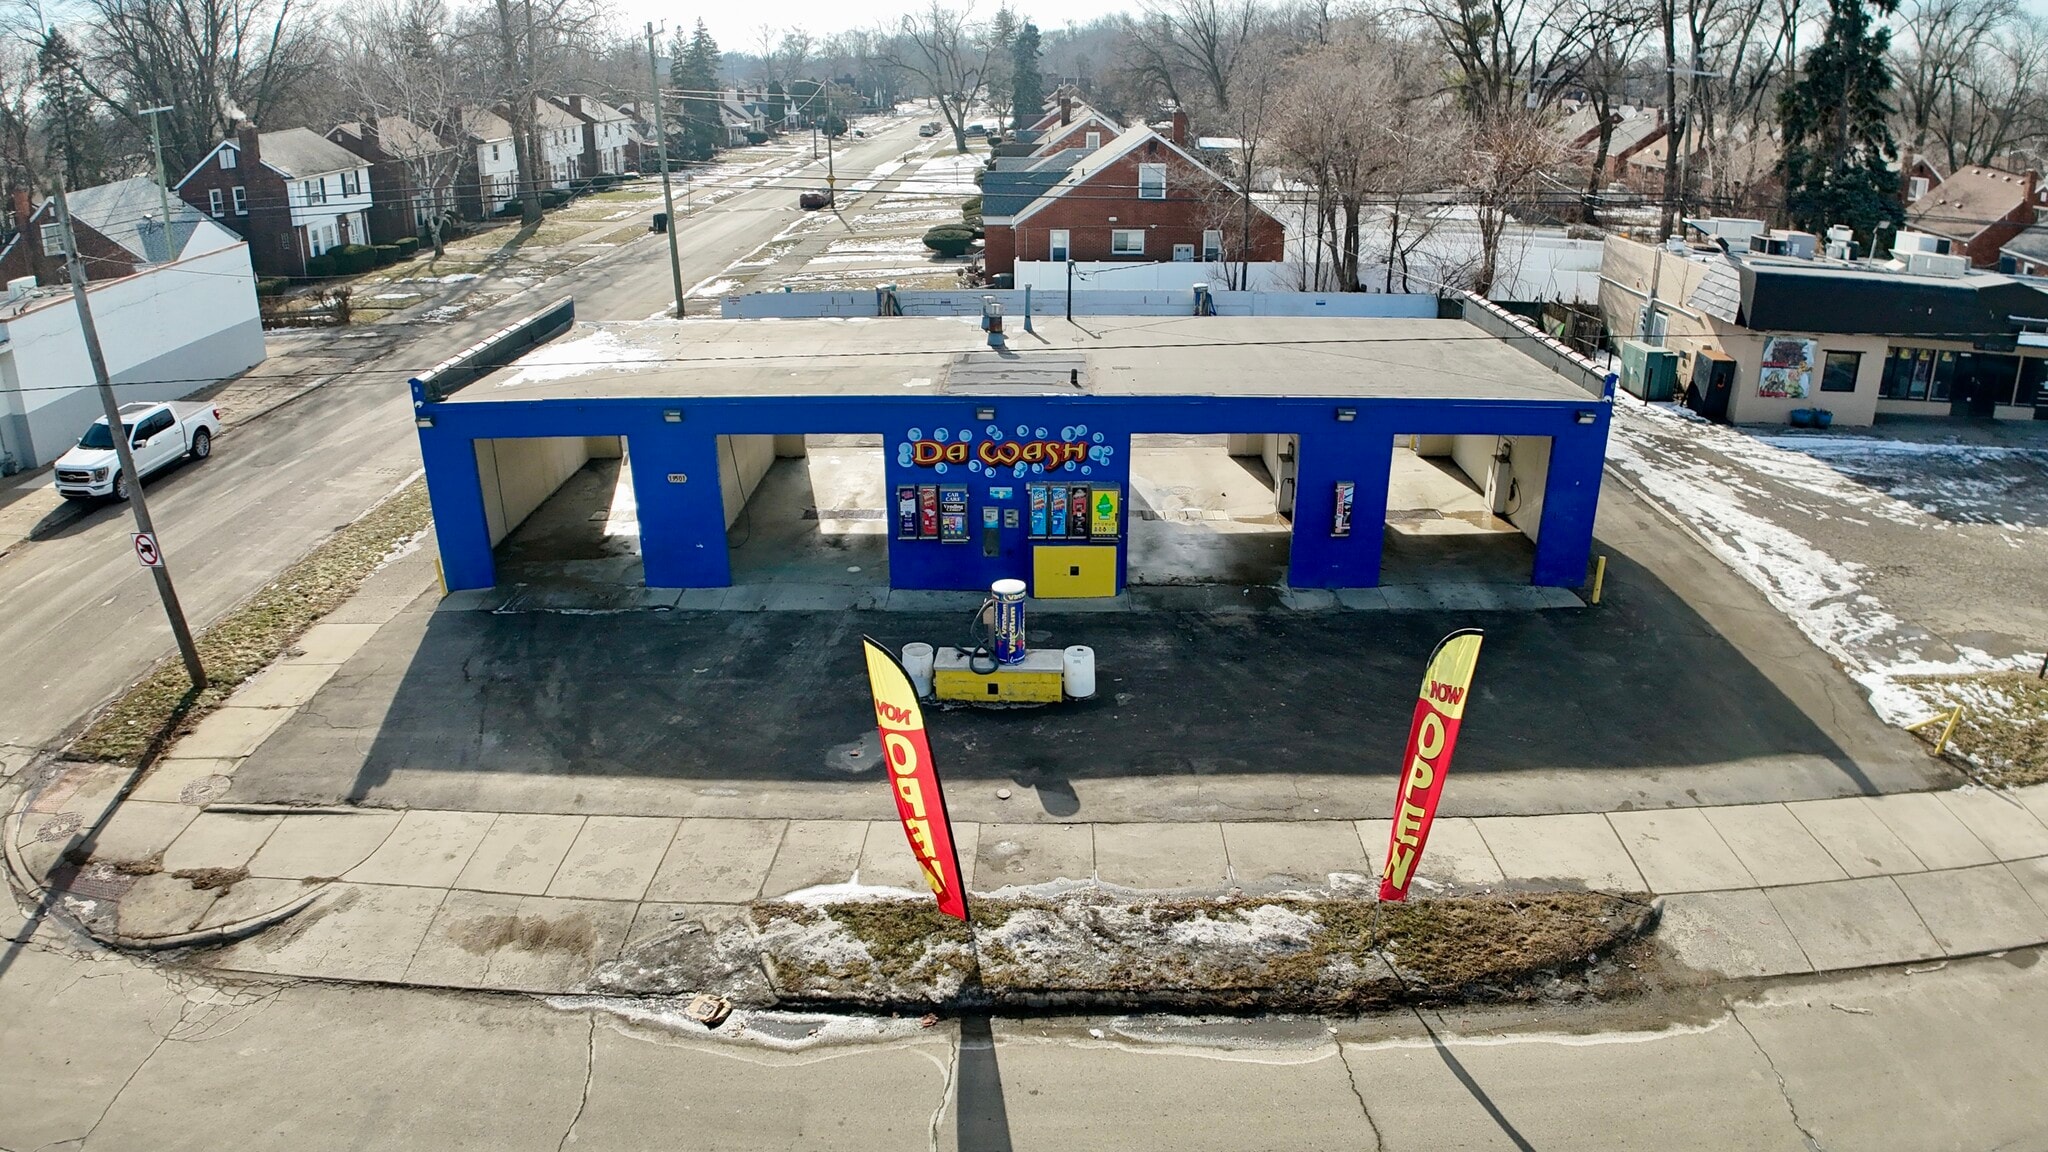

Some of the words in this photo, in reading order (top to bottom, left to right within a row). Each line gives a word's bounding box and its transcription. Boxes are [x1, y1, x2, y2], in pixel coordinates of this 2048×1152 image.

[912, 440, 969, 465] DA
[977, 439, 1089, 470] WASH
[1430, 680, 1465, 705] NOW
[1383, 712, 1446, 890] OPEN
